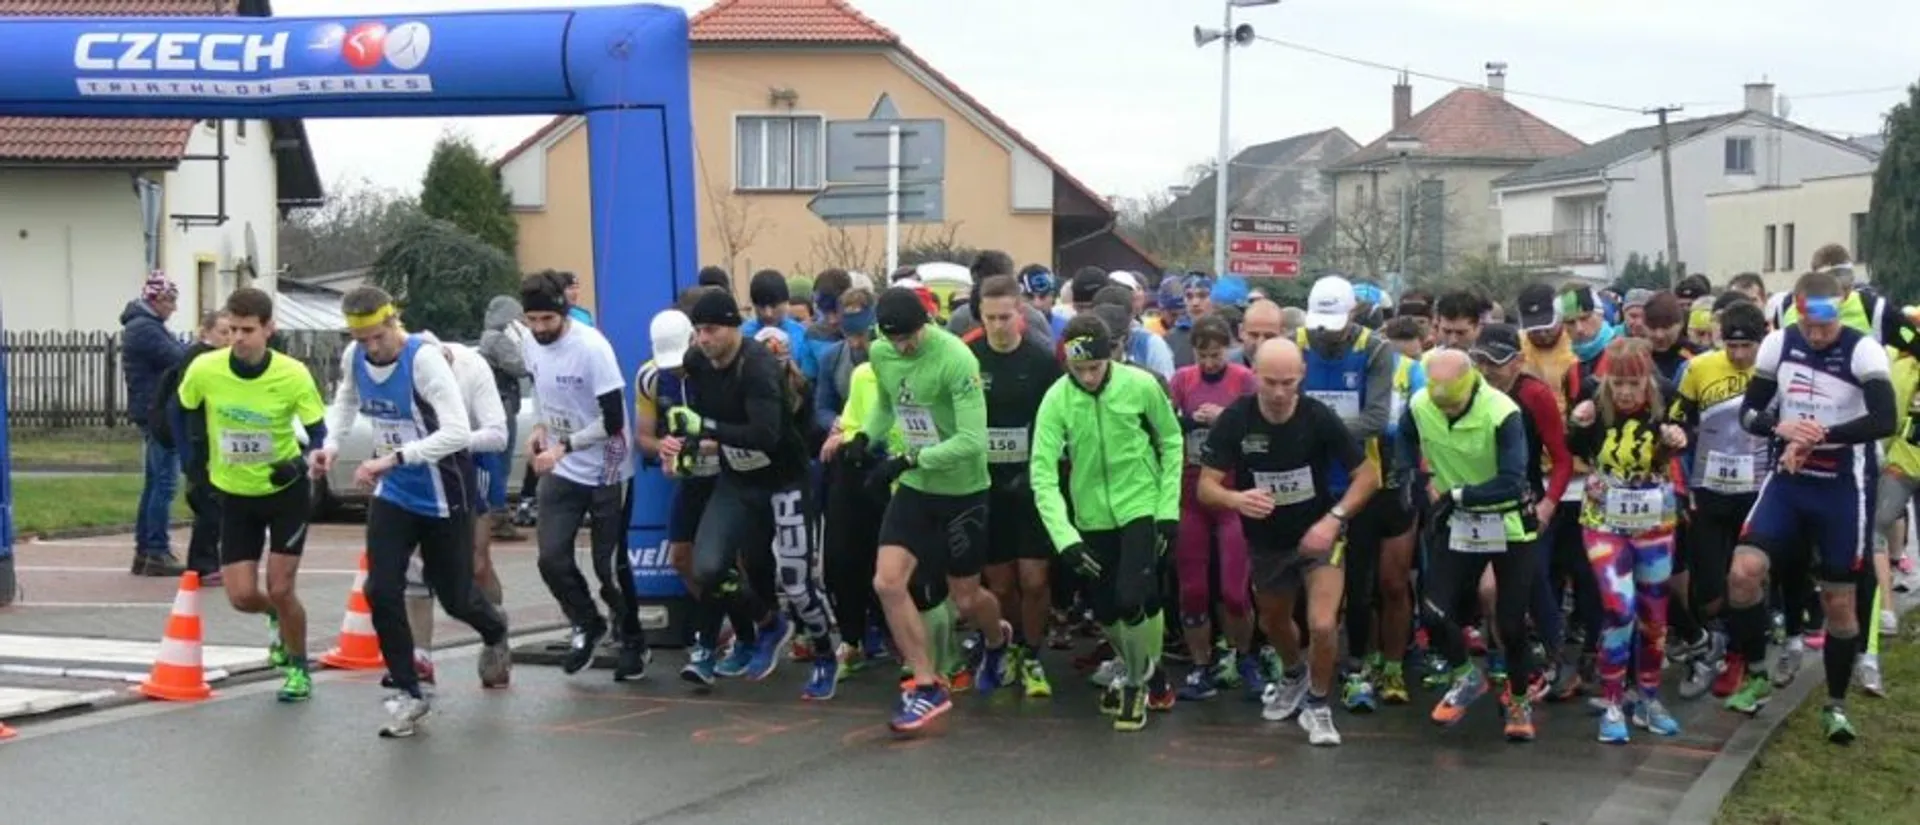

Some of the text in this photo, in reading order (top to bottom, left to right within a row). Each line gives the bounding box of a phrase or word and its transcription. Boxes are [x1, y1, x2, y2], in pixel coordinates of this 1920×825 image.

[75, 32, 289, 72] CZECH
[87, 78, 420, 96] TRIATHLON SERIES
